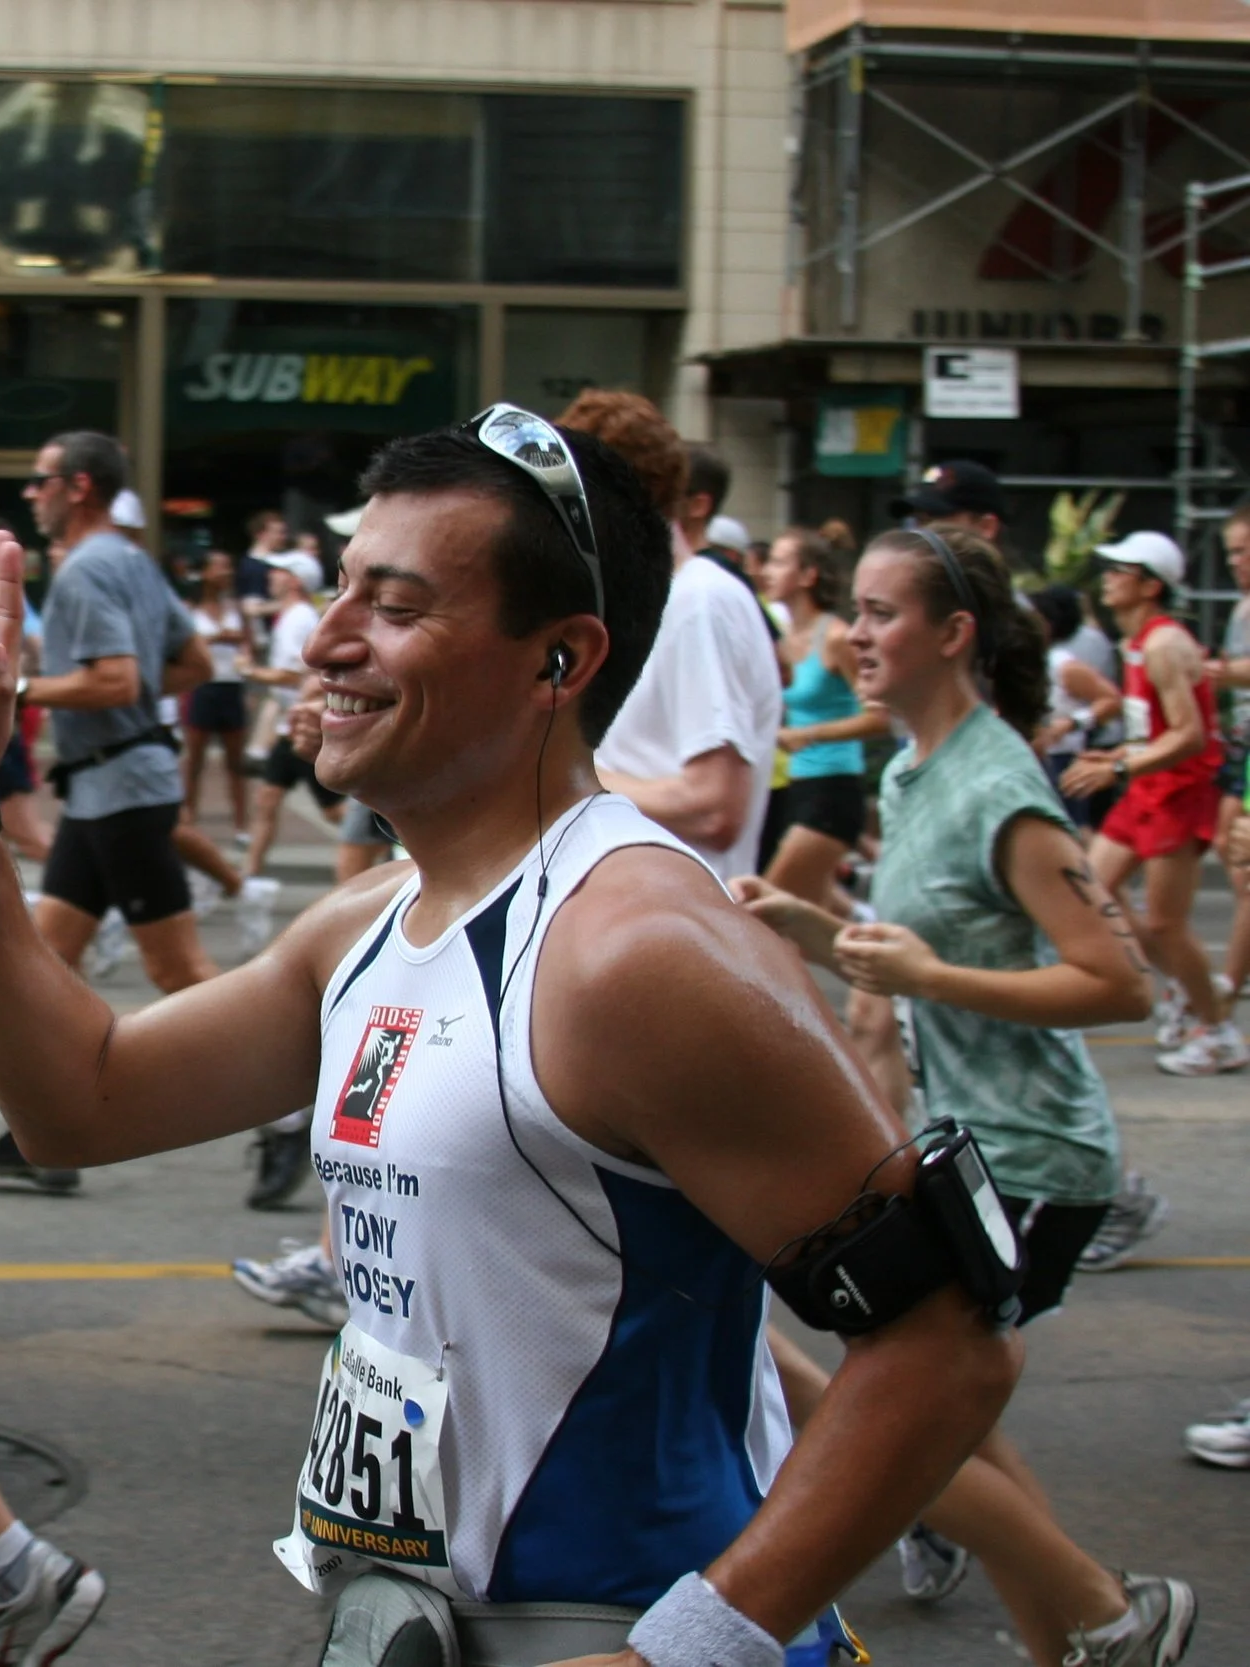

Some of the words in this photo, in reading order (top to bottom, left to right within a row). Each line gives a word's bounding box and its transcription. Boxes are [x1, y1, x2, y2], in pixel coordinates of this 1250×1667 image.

[183, 353, 434, 404] SUBWAY
[370, 1007, 412, 1027] AIDS
[314, 1152, 382, 1191] Because
[387, 1163, 419, 1197] I'm
[341, 1204, 397, 1259] TONY
[342, 1256, 415, 1318] HOSEY
[367, 1364, 403, 1402] Bank
[308, 1377, 426, 1531] 42851
[311, 1515, 429, 1557] ANNIVERSARY
[315, 1555, 343, 1577] 2007
